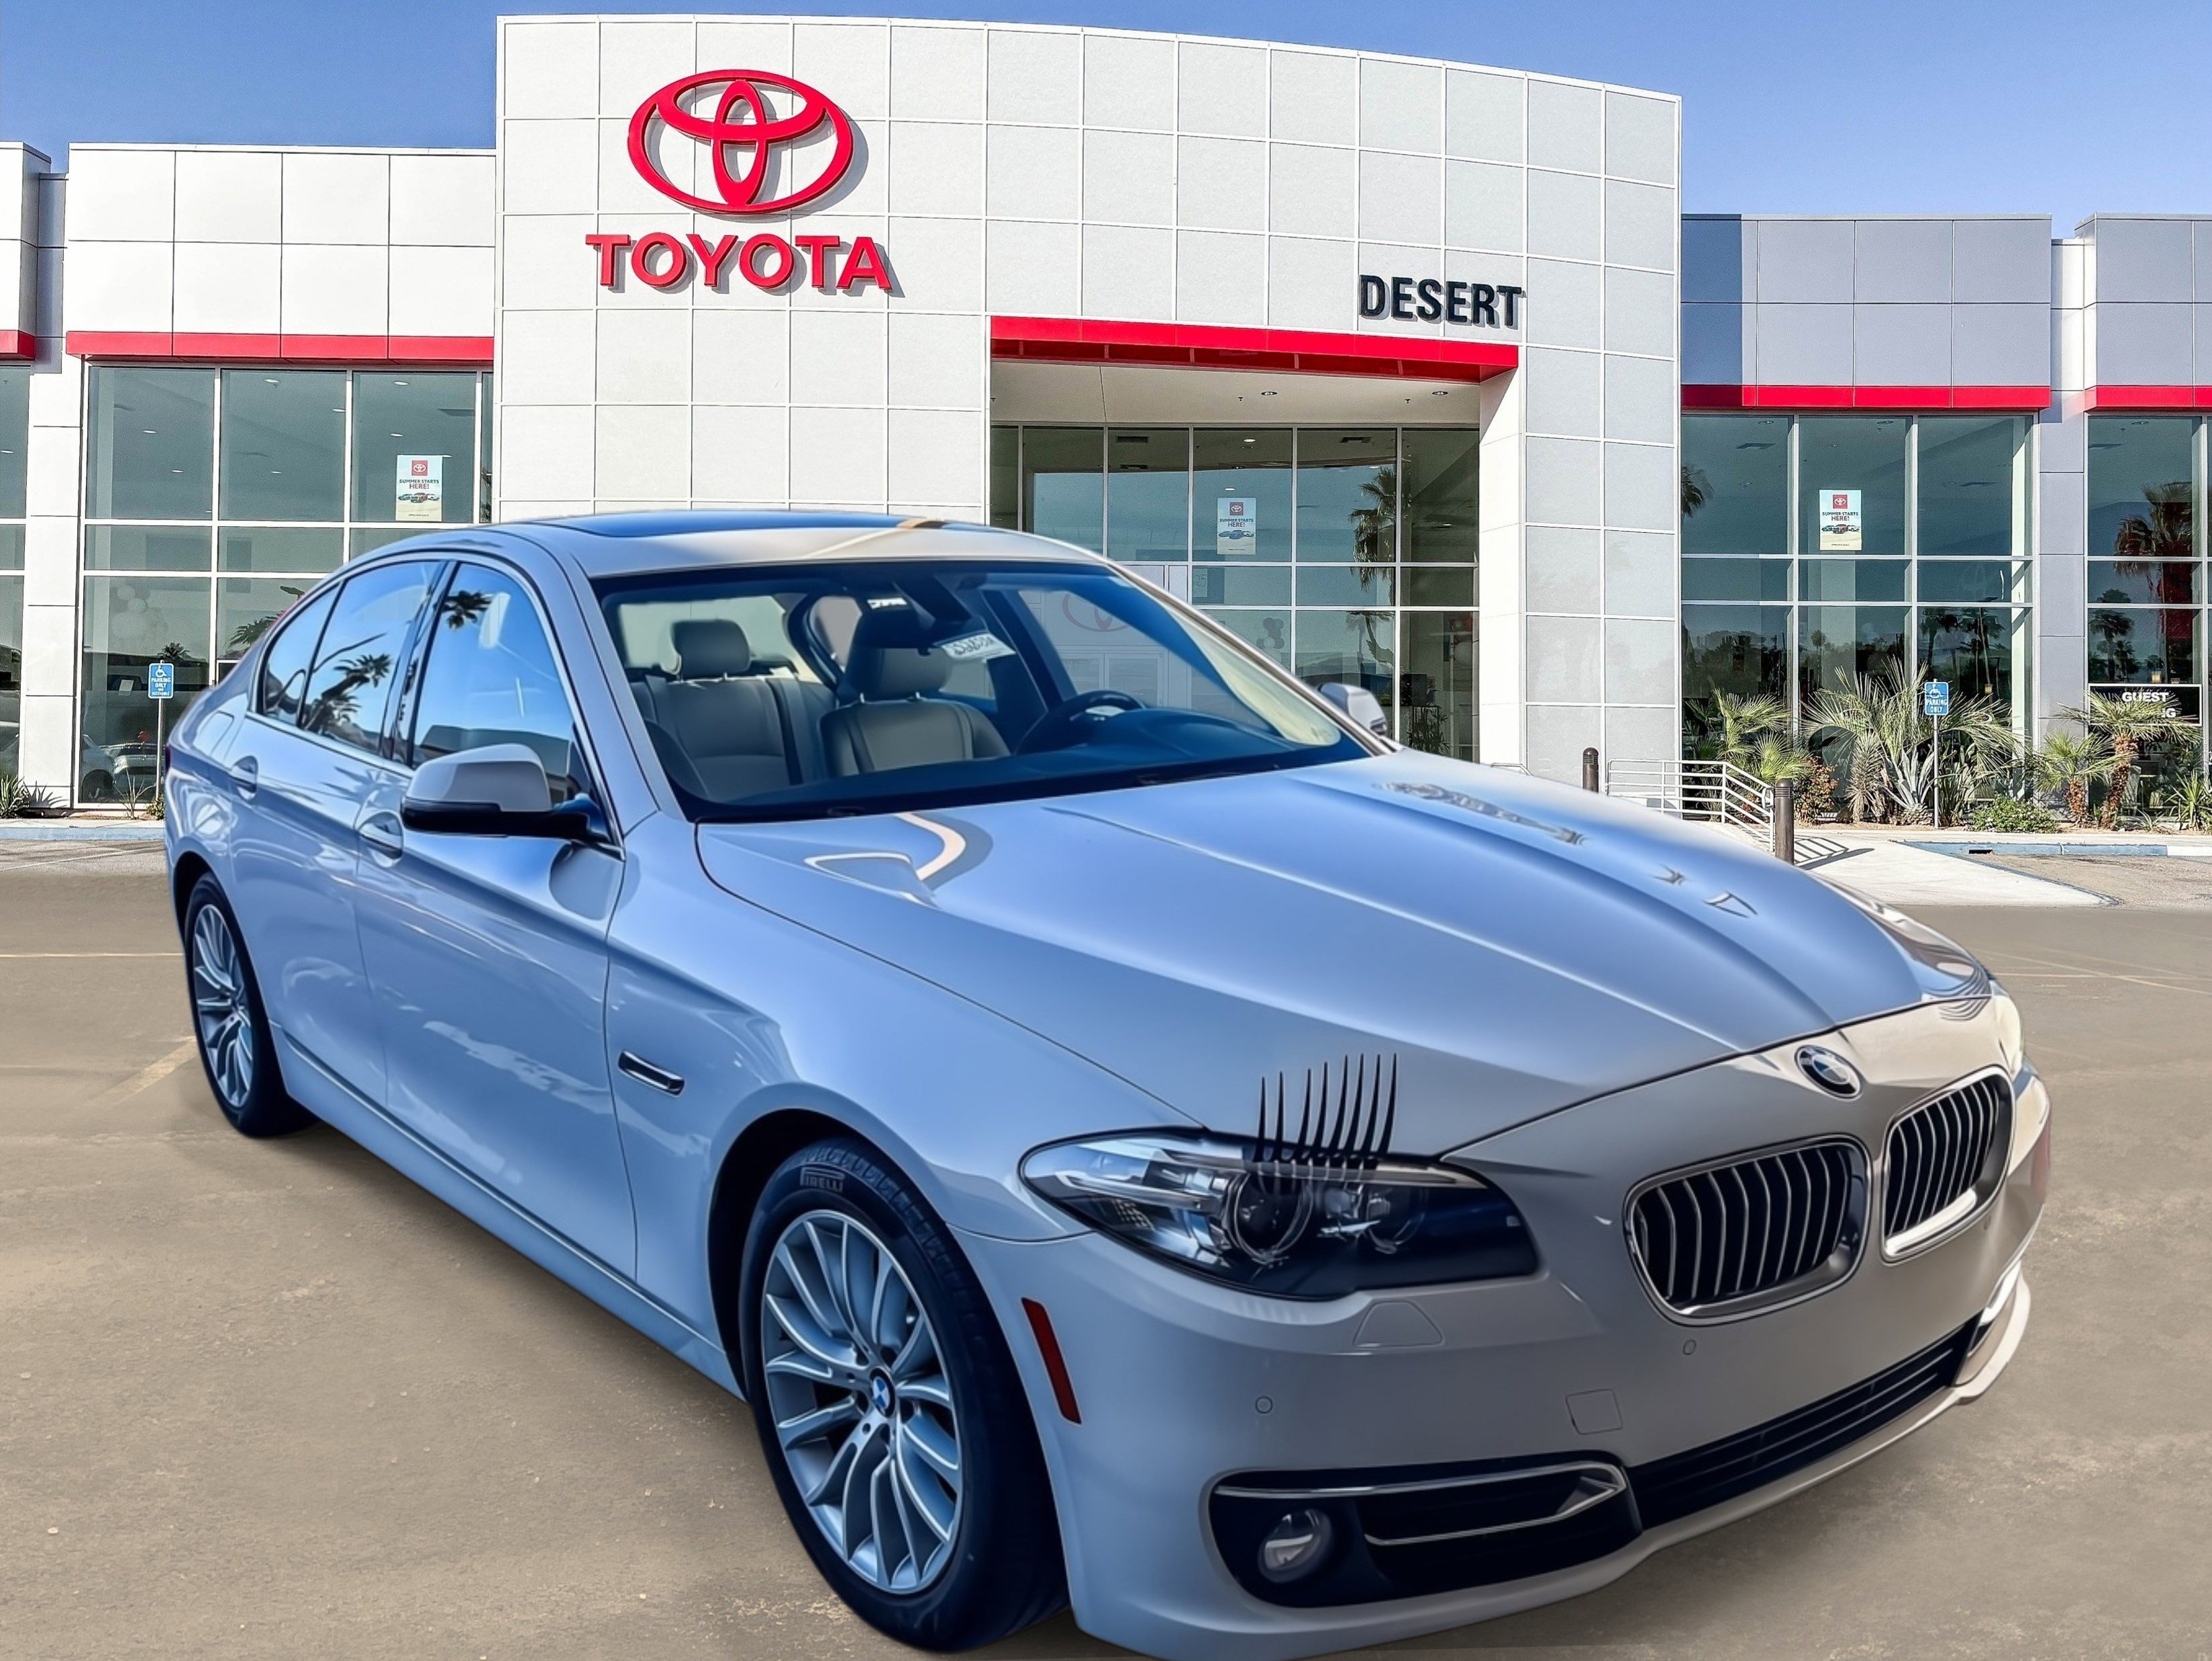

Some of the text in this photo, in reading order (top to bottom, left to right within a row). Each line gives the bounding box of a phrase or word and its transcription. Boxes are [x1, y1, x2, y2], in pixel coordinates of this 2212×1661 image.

[585, 232, 893, 291] TOYOTA
[1358, 274, 1522, 327] DESERT
[2121, 691, 2169, 703] GUEST
[800, 1167, 845, 1193] PIRELLI
